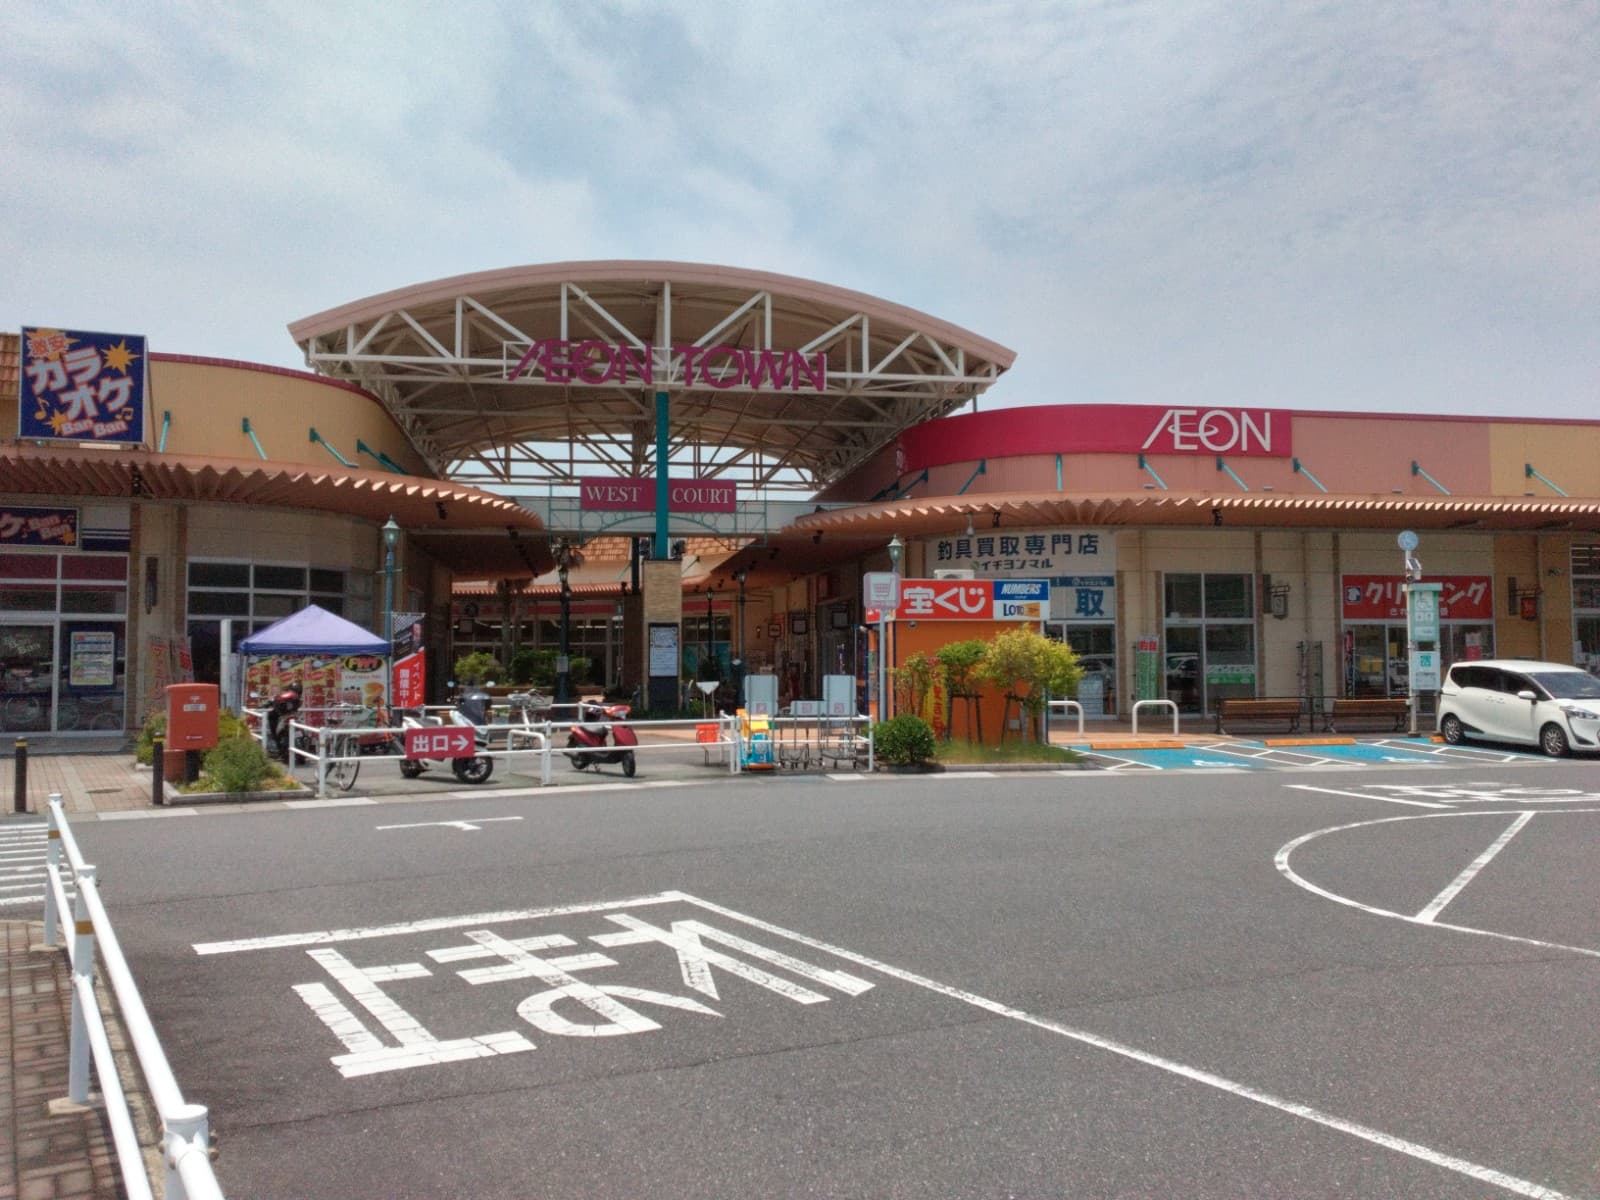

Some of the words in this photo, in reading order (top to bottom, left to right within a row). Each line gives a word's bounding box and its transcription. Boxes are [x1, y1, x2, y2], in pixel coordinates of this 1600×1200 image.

[674, 345, 827, 391] TOWN
[586, 486, 642, 502] WEST
[672, 487, 733, 504] COURT
[938, 533, 1099, 561] 釣具買取専門店
[903, 587, 986, 614] 宝くじ
[1001, 583, 1042, 595] NUMBERS
[412, 735, 456, 753] 出口
[292, 913, 875, 1078] 止まれ
